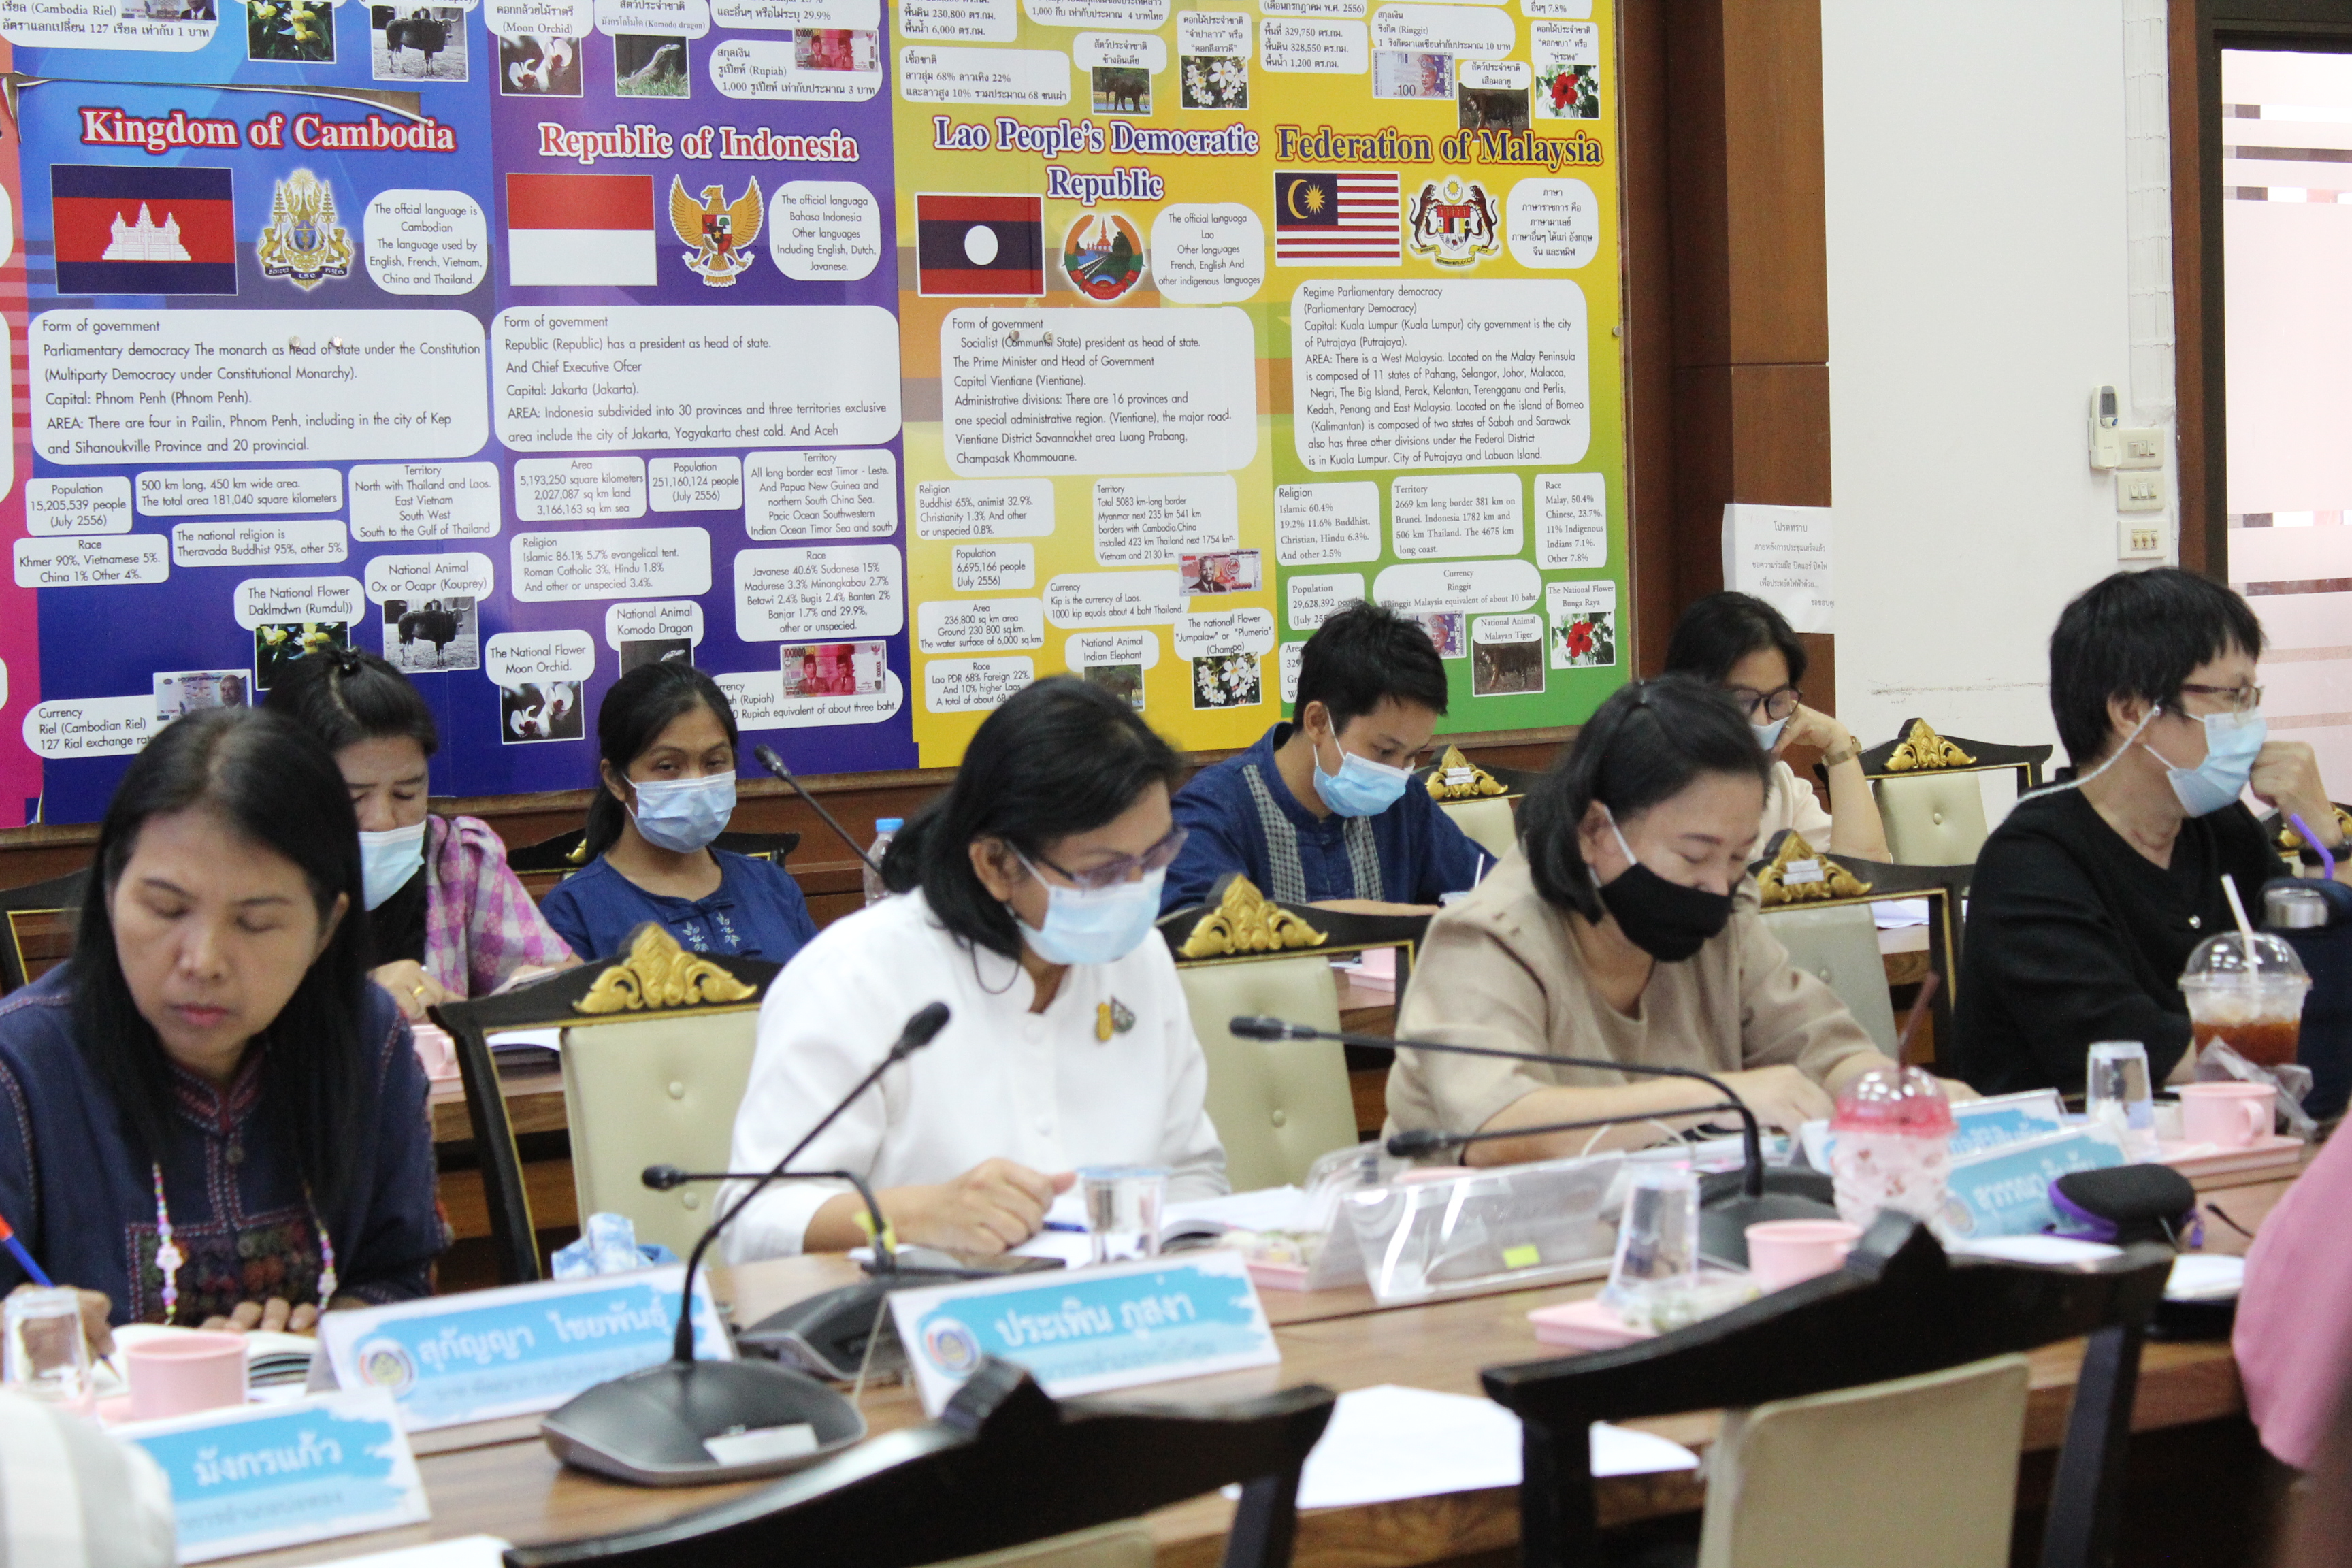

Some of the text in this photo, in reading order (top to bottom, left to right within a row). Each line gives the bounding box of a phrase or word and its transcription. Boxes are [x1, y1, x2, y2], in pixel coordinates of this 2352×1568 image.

[497, 2, 574, 16] ดอกกล้วยไม้ราตรี
[904, 3, 996, 20] พื้นดิน 230,800 ตร.กม.
[3, 18, 210, 37] อัตราแลกเปลี่ยน 127 เรียล เท่ากับ 1 บาท
[503, 21, 573, 35] (Moon Orchid)
[1377, 23, 1428, 37] ริงกิต (Ringgit)
[1094, 38, 1147, 50] สัตว์ประจำชาติ
[717, 47, 751, 61] สกุลเงิน
[1102, 53, 1139, 65] ช้างอินเดีย
[718, 63, 787, 78] รูเปียห์ (Rupiah)
[906, 70, 1011, 84] ลาวลุ่ม 68% ลาวเทิง 22%
[1397, 84, 1416, 96] 100
[81, 110, 456, 151] Kingdom of Cambodia
[935, 118, 1258, 157] Lao People's Democratic
[539, 123, 858, 163] Republic of Indonesia
[1277, 127, 1602, 171] Federation of Malaysia
[1047, 167, 1164, 205] Republic
[1571, 201, 1582, 212] คือ
[1530, 216, 1571, 226] ภาษามาเลย์
[370, 255, 482, 270] English, French, Vietnam,
[382, 272, 475, 284] China and Thailand.
[1303, 284, 1443, 300] Regime Parliamentary democracy
[1304, 301, 1417, 316] (Parliamentary Democracy)
[42, 318, 160, 336] Form of government
[504, 314, 608, 331] Form of government
[953, 316, 1044, 332] Form of government
[505, 336, 549, 353] Republic
[553, 336, 603, 353] (Republic)
[607, 336, 625, 349] has
[640, 336, 685, 353] president
[689, 340, 700, 348] as
[704, 336, 729, 348] head
[732, 335, 743, 348] of
[747, 338, 771, 348] state.
[953, 354, 1154, 368] The Prime Minister and Head of Government
[954, 374, 1086, 390] Capital Vientiane (Vientiane).
[506, 382, 639, 399] Capital: Jakarta (Jakarta).
[46, 389, 252, 408] Capital: Phnom Penh (Phnom Penh).
[48, 436, 309, 455] and Sihanoukville Province and 20 provincial.
[956, 451, 1077, 467] Champasak Khammouane.
[520, 472, 644, 487] 5,193,250 square kilometers
[52, 483, 103, 497] Population
[31, 497, 127, 512] 15,205,539 people
[1546, 494, 1594, 506] Malay, 50.4%
[50, 514, 107, 529] (July 2556)
[1395, 510, 1511, 524] Brunei. Indonesia 1782 km and
[1546, 509, 1603, 519] Chinese, 23.7%.
[20, 553, 160, 567] Khmer 90%, Vietnamese 5%.
[957, 559, 1026, 573] 6,695,166 people
[524, 561, 664, 577] Roman Catholic 3%, Hindu 1.8%
[1563, 598, 1600, 609] Bunga Raya
[617, 622, 693, 636] Komodo Dragon
[1485, 631, 1533, 642] Malayan Tiger
[1083, 649, 1142, 662] Indian Elephant
[506, 659, 572, 674] Moon Orchid.
[39, 717, 146, 735] Riel (Cambodian Riel)
